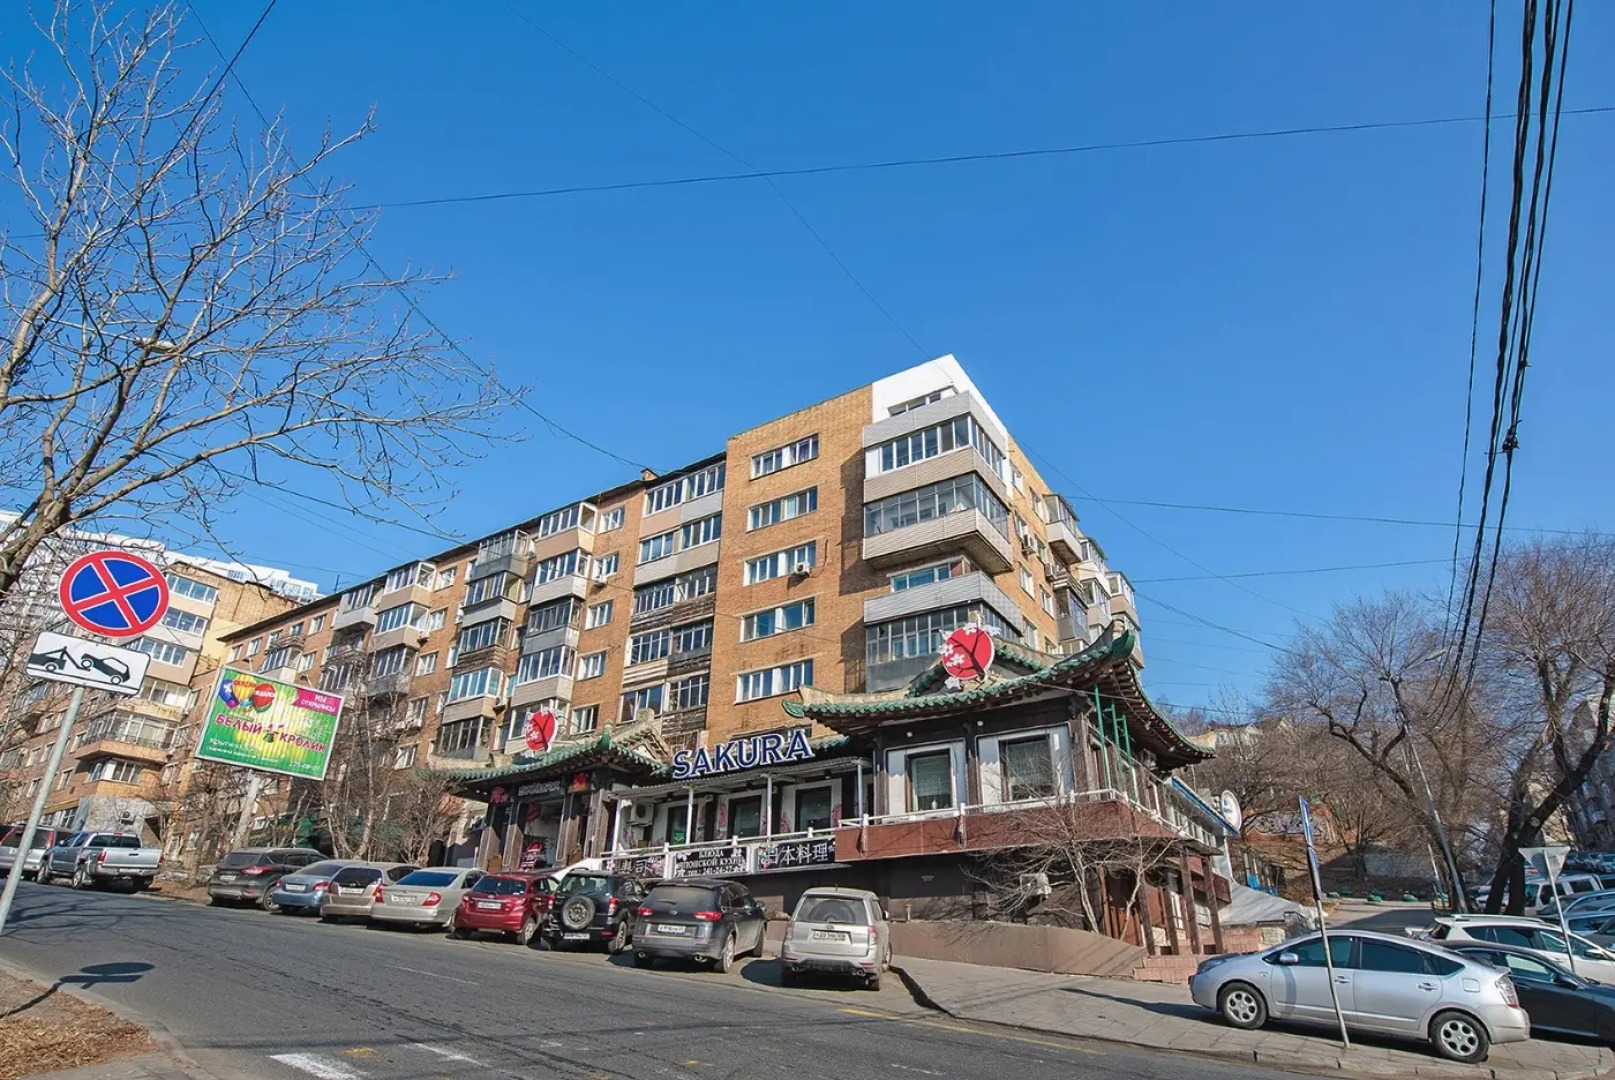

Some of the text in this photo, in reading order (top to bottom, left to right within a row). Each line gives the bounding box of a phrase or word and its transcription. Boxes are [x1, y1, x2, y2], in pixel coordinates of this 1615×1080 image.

[216, 714, 261, 733] БЕЛЫЙ
[280, 734, 325, 752] КРОЛИК
[672, 728, 815, 779] SAKURA
[767, 842, 828, 866] 日本料理
